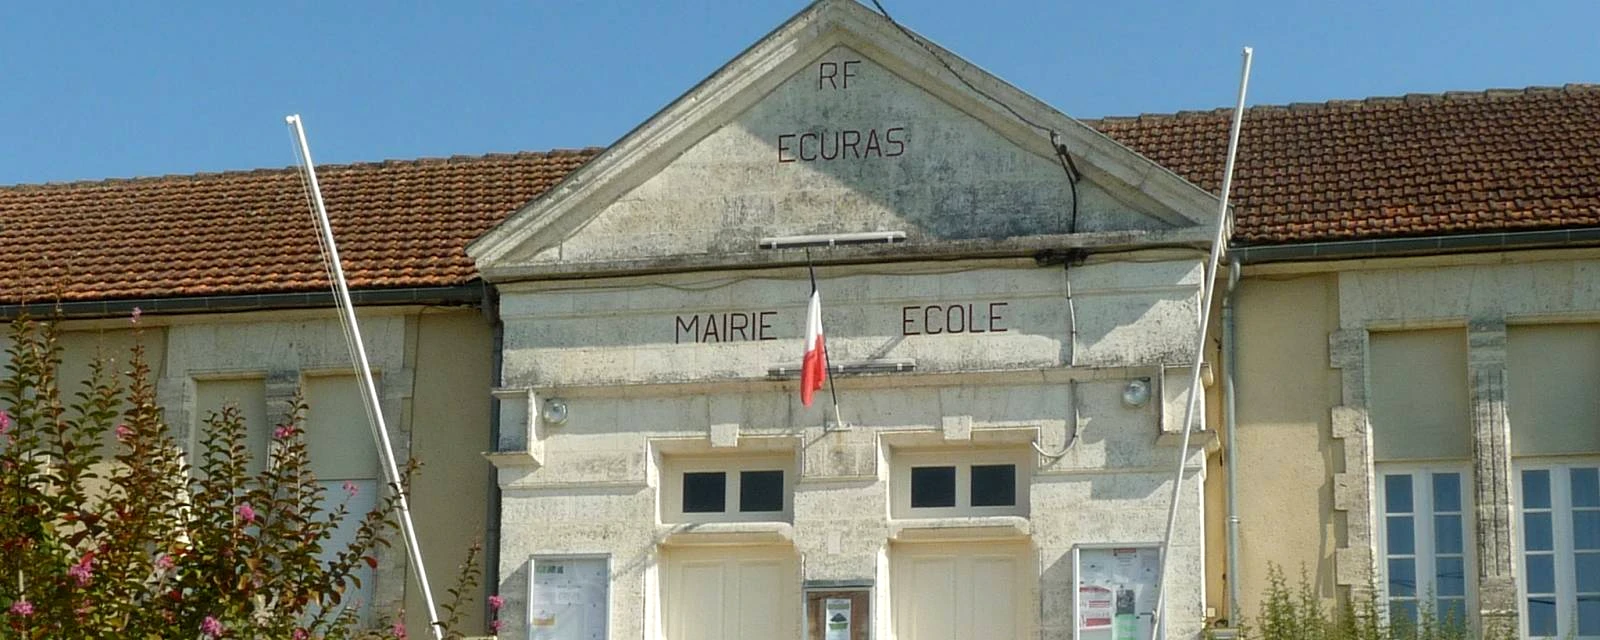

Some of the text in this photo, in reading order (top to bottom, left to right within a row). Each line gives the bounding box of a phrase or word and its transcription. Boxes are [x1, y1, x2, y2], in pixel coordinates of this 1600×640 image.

[819, 60, 862, 90] RF
[778, 127, 905, 163] ECURAS
[675, 302, 1008, 344] MAIRIE ECOLE
